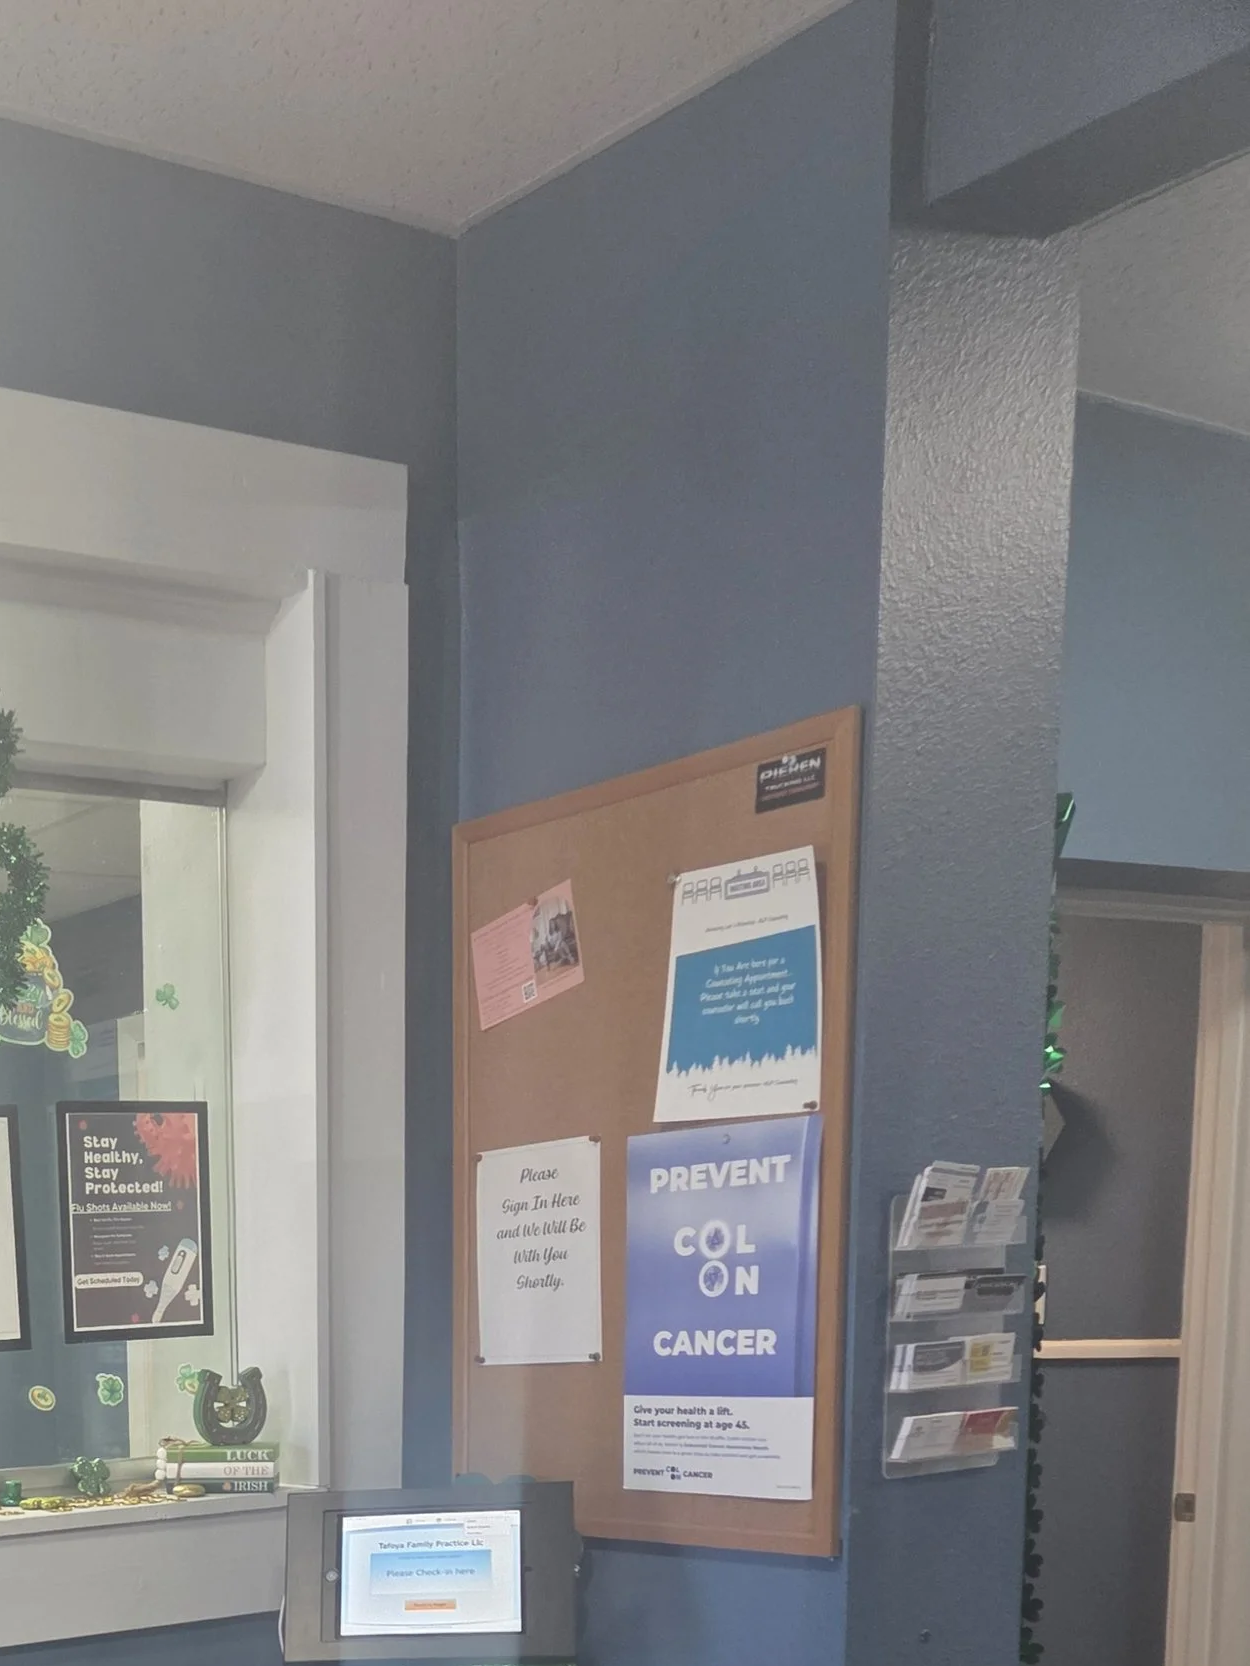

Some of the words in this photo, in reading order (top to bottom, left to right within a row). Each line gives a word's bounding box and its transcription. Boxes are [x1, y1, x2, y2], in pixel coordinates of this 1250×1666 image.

[0, 1004, 43, 1030] Blessed
[84, 1136, 117, 1149] Stay
[84, 1151, 143, 1164] Healthy,
[85, 1167, 118, 1180] Stay
[520, 1168, 558, 1183] Please
[651, 1155, 791, 1193] PREVENT
[86, 1181, 163, 1194] Protected!
[71, 1203, 84, 1212] Flu
[86, 1203, 110, 1212] Shots
[112, 1202, 148, 1211] Available
[502, 1199, 528, 1216] Sign
[531, 1195, 547, 1211] In
[551, 1193, 581, 1208] Here
[497, 1224, 520, 1239] and
[523, 1222, 540, 1237] We
[543, 1220, 567, 1235] Will
[570, 1218, 587, 1233] Be
[674, 1220, 756, 1259] COL
[514, 1249, 540, 1264] With
[543, 1246, 568, 1265] You
[516, 1273, 564, 1291] Shortly.
[699, 1260, 759, 1297] ON
[653, 1329, 776, 1356] CANCER
[634, 1405, 652, 1415] Give
[655, 1407, 674, 1416] your
[677, 1406, 706, 1415] health
[717, 1406, 733, 1415] lift.
[634, 1419, 654, 1427] Start
[657, 1419, 701, 1430] screening
[704, 1420, 713, 1428] at
[716, 1422, 733, 1430] age
[735, 1420, 750, 1429] 45.
[226, 1450, 269, 1460] LUCK
[224, 1466, 238, 1476] OF
[244, 1466, 269, 1475] THE
[634, 1468, 664, 1476] PREVENT
[683, 1471, 712, 1479] CANCER
[234, 1481, 268, 1491] IRISH
[378, 1542, 404, 1550] Tafoya
[407, 1541, 433, 1549] Family
